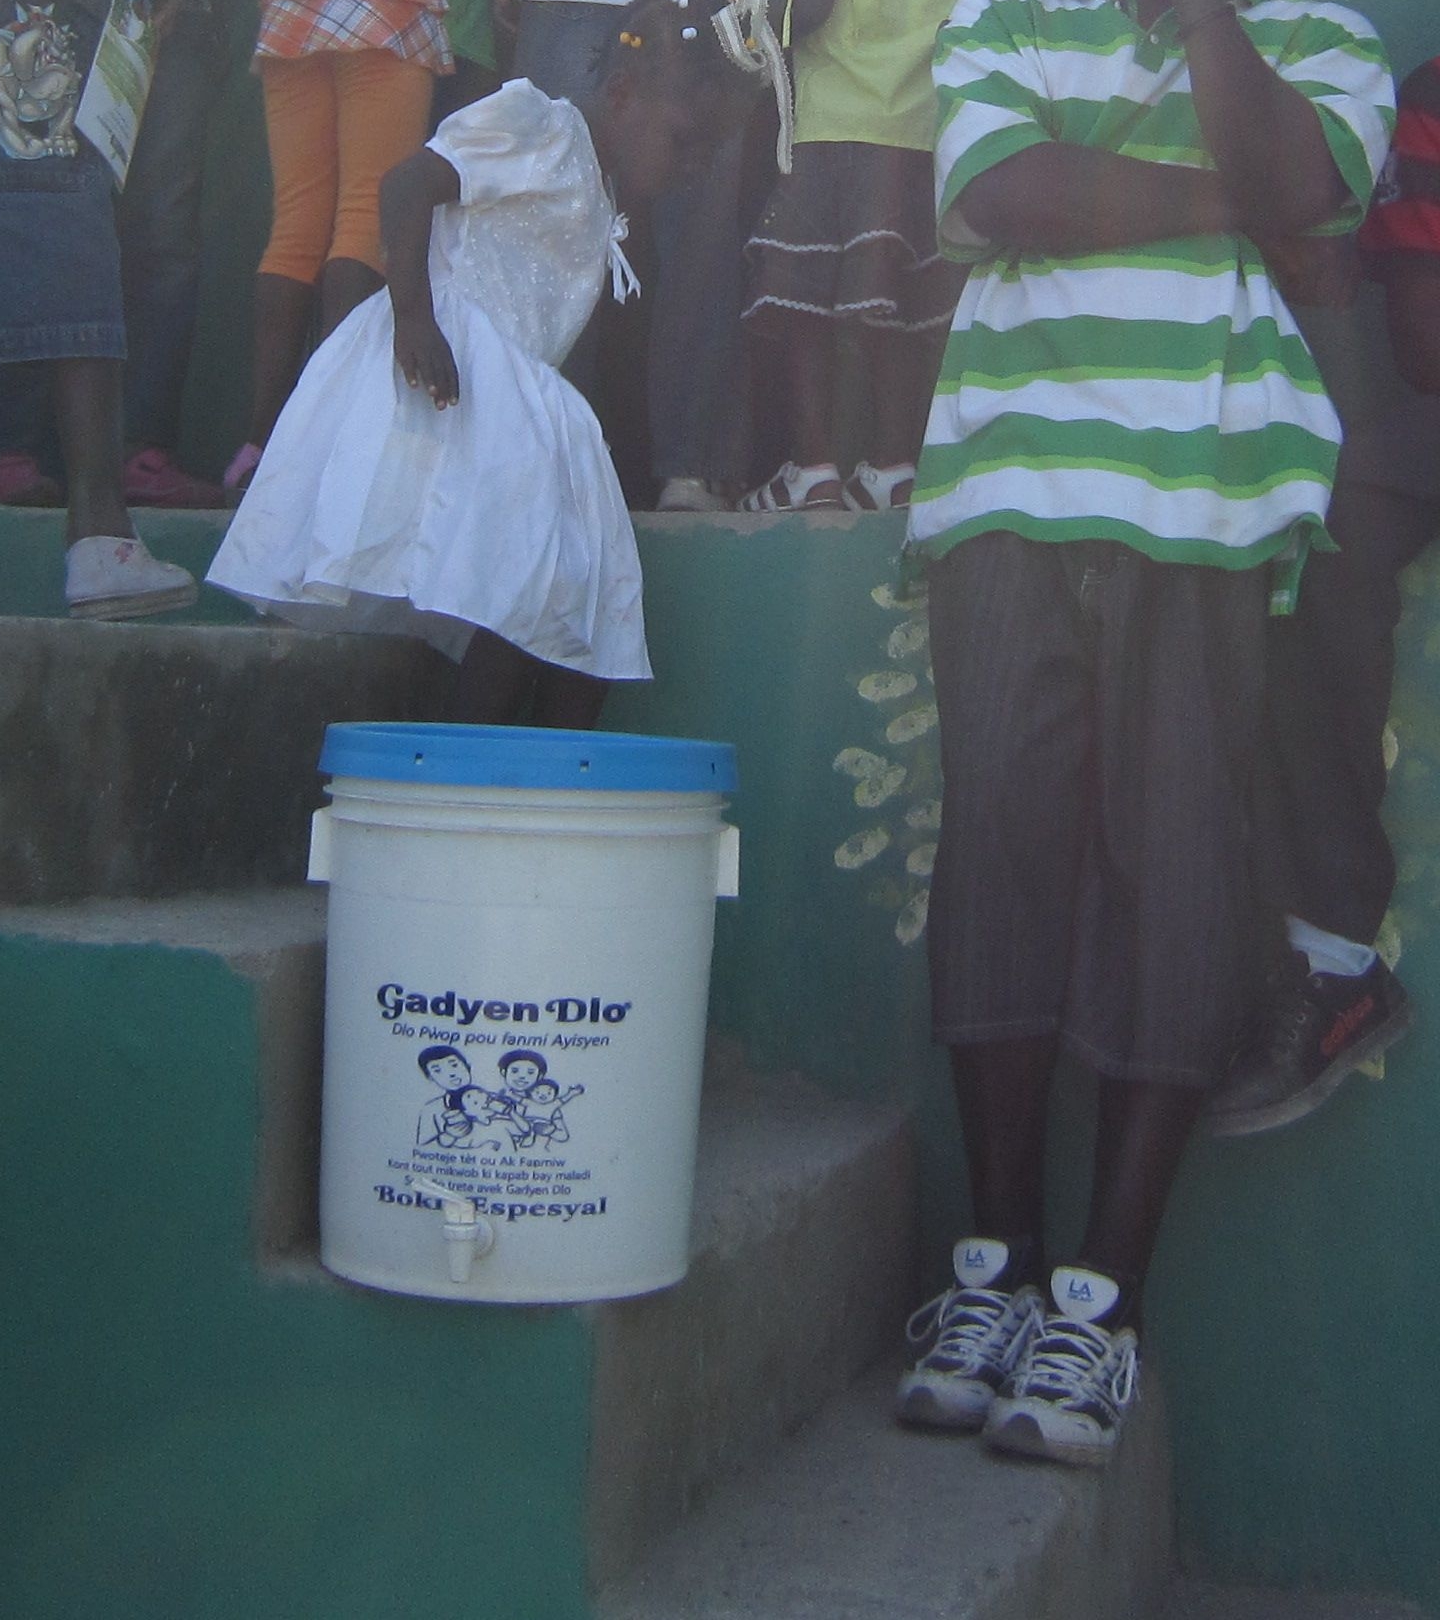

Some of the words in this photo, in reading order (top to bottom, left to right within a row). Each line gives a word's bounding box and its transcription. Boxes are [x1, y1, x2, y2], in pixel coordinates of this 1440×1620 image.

[376, 982, 540, 1026] Gadyen
[544, 995, 628, 1024] Dlo
[391, 1021, 415, 1038] Dlo
[464, 1032, 497, 1047] pou
[500, 1032, 548, 1048] fanmi
[550, 1032, 610, 1050] Ayisyen
[479, 1155, 497, 1166] ou
[464, 1195, 608, 1223] Espesyal
[965, 1248, 985, 1264] LA
[1068, 1278, 1092, 1298] LA
